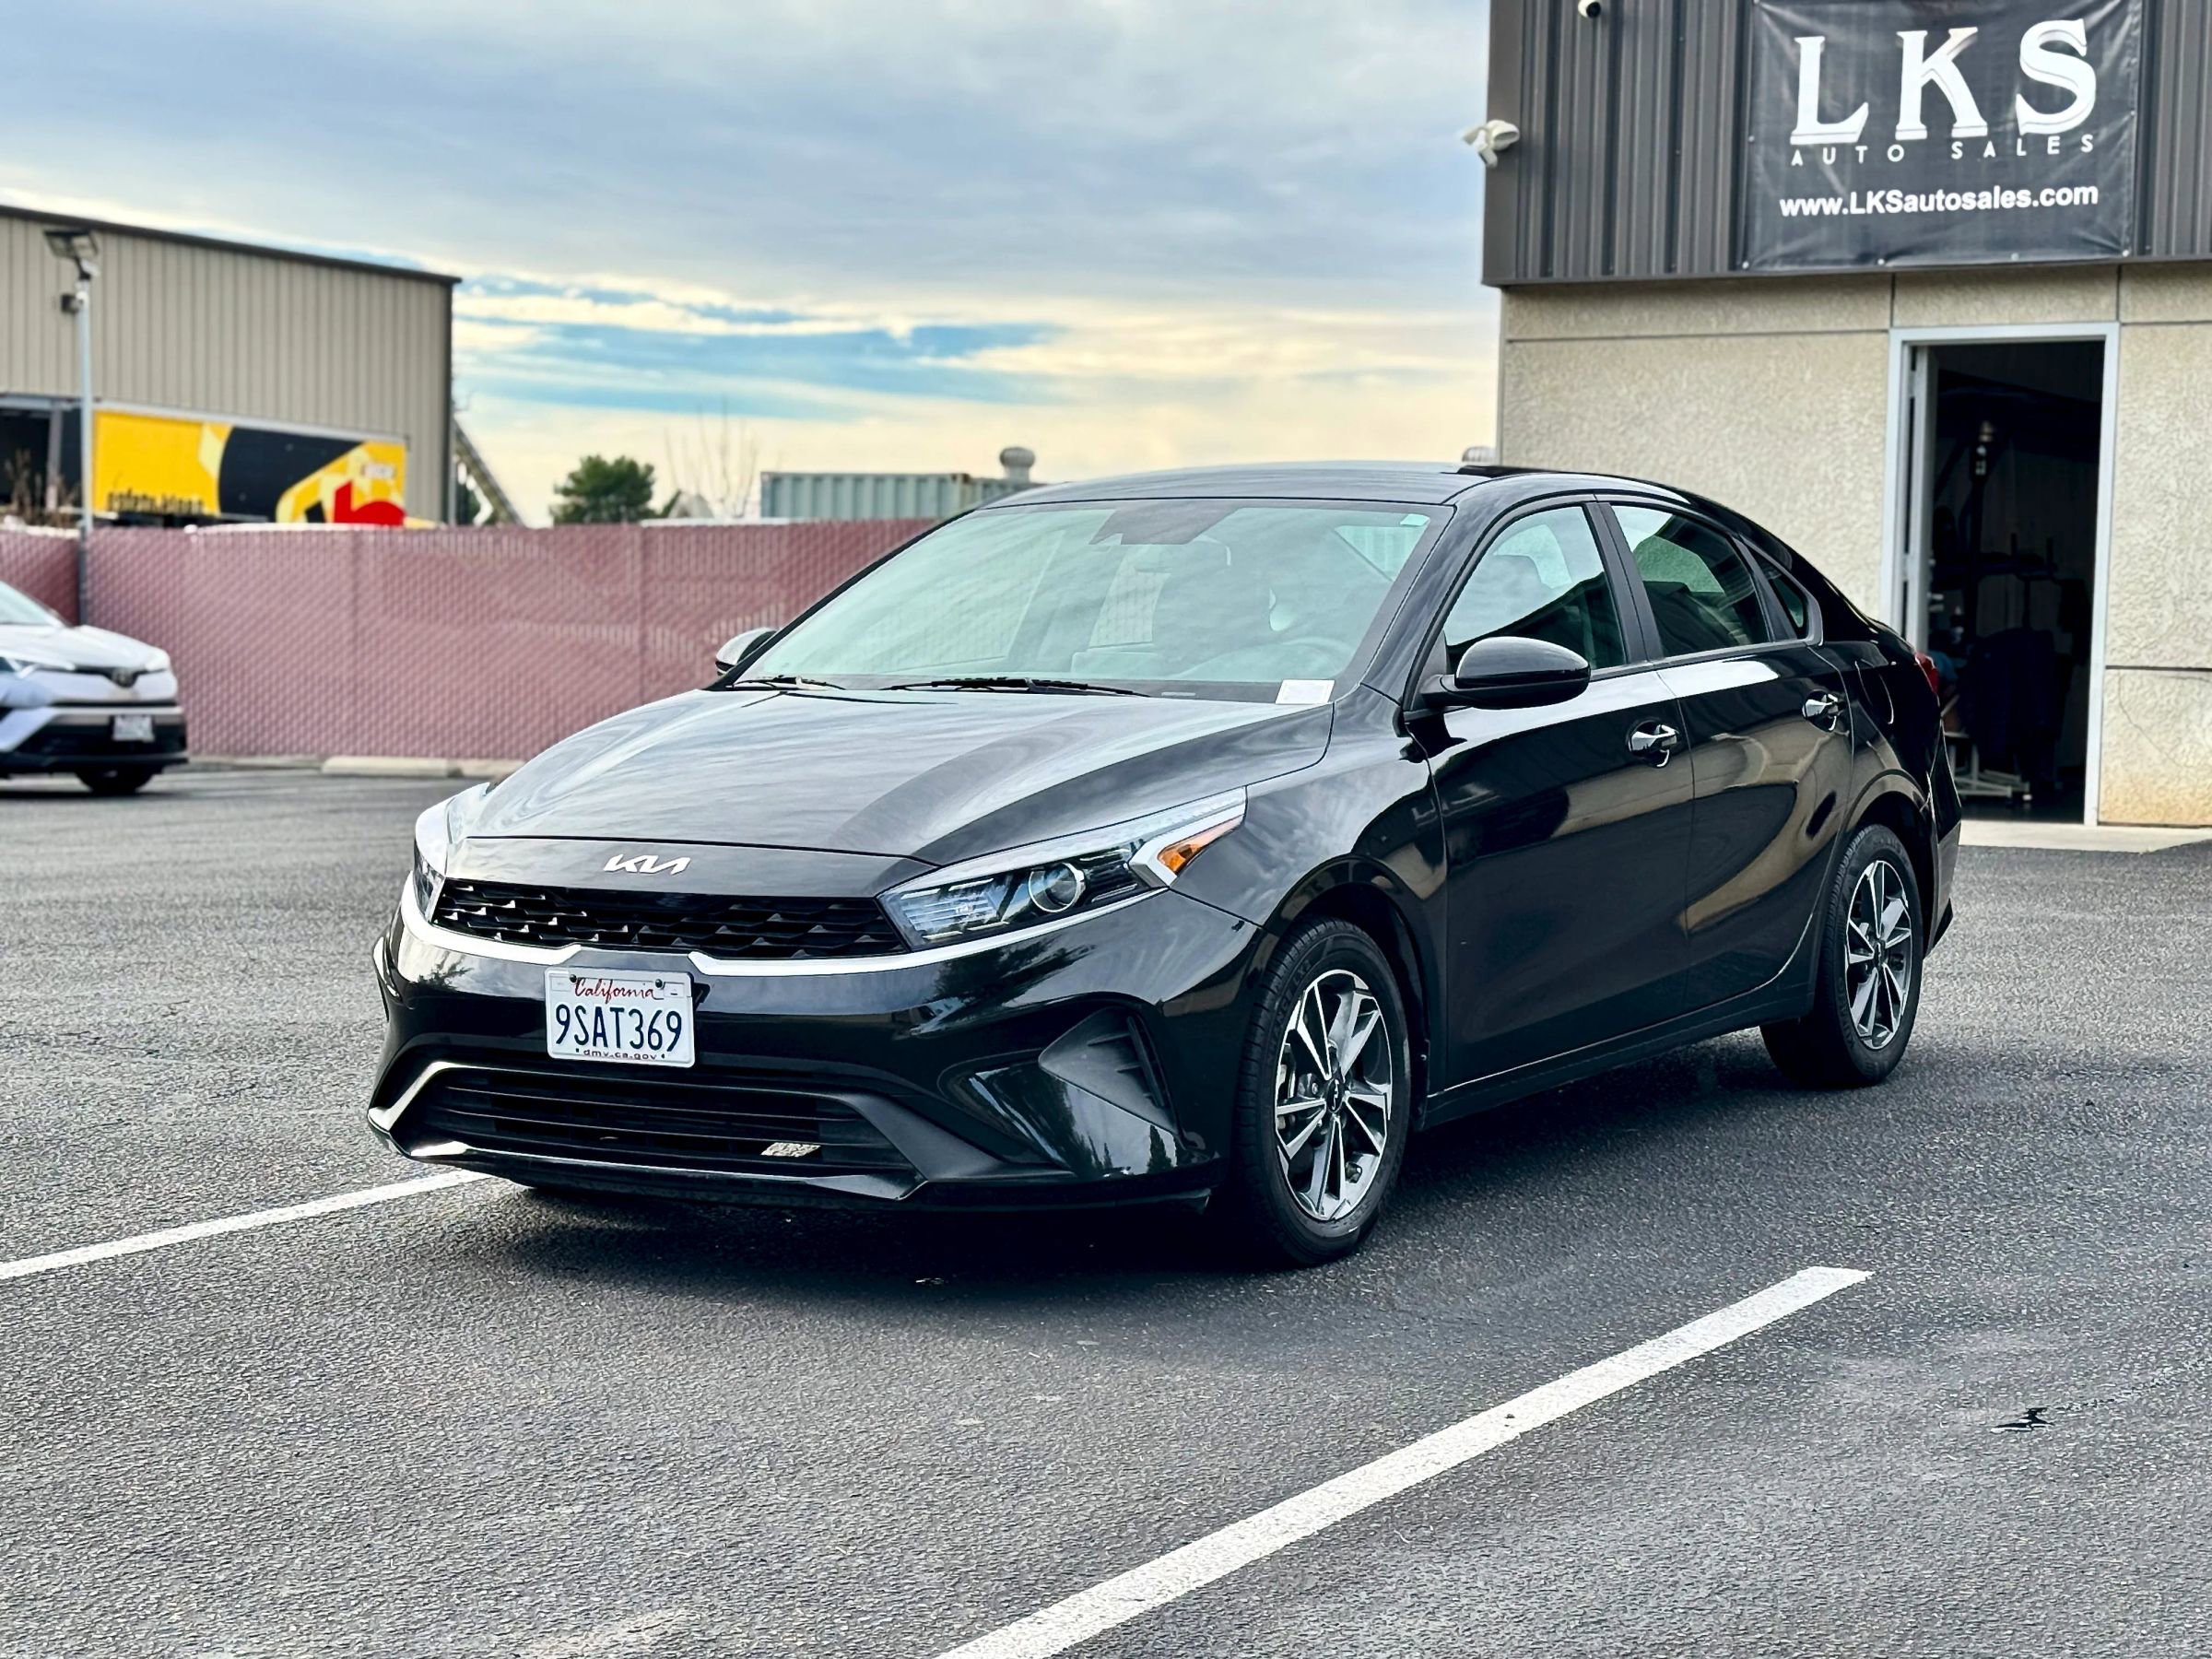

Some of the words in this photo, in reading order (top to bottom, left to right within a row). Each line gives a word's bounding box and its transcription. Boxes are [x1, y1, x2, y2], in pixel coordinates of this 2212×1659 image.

[1790, 18, 2097, 145] LKS
[1791, 145, 1905, 167] AUTO
[1951, 134, 2093, 160] SALES
[1780, 185, 2099, 217] www.LKSautosales.com
[603, 854, 691, 875] KIA
[575, 977, 664, 1004] California
[556, 1004, 682, 1053] 9SAT369
[583, 1049, 657, 1060] dmv.ca.gov
